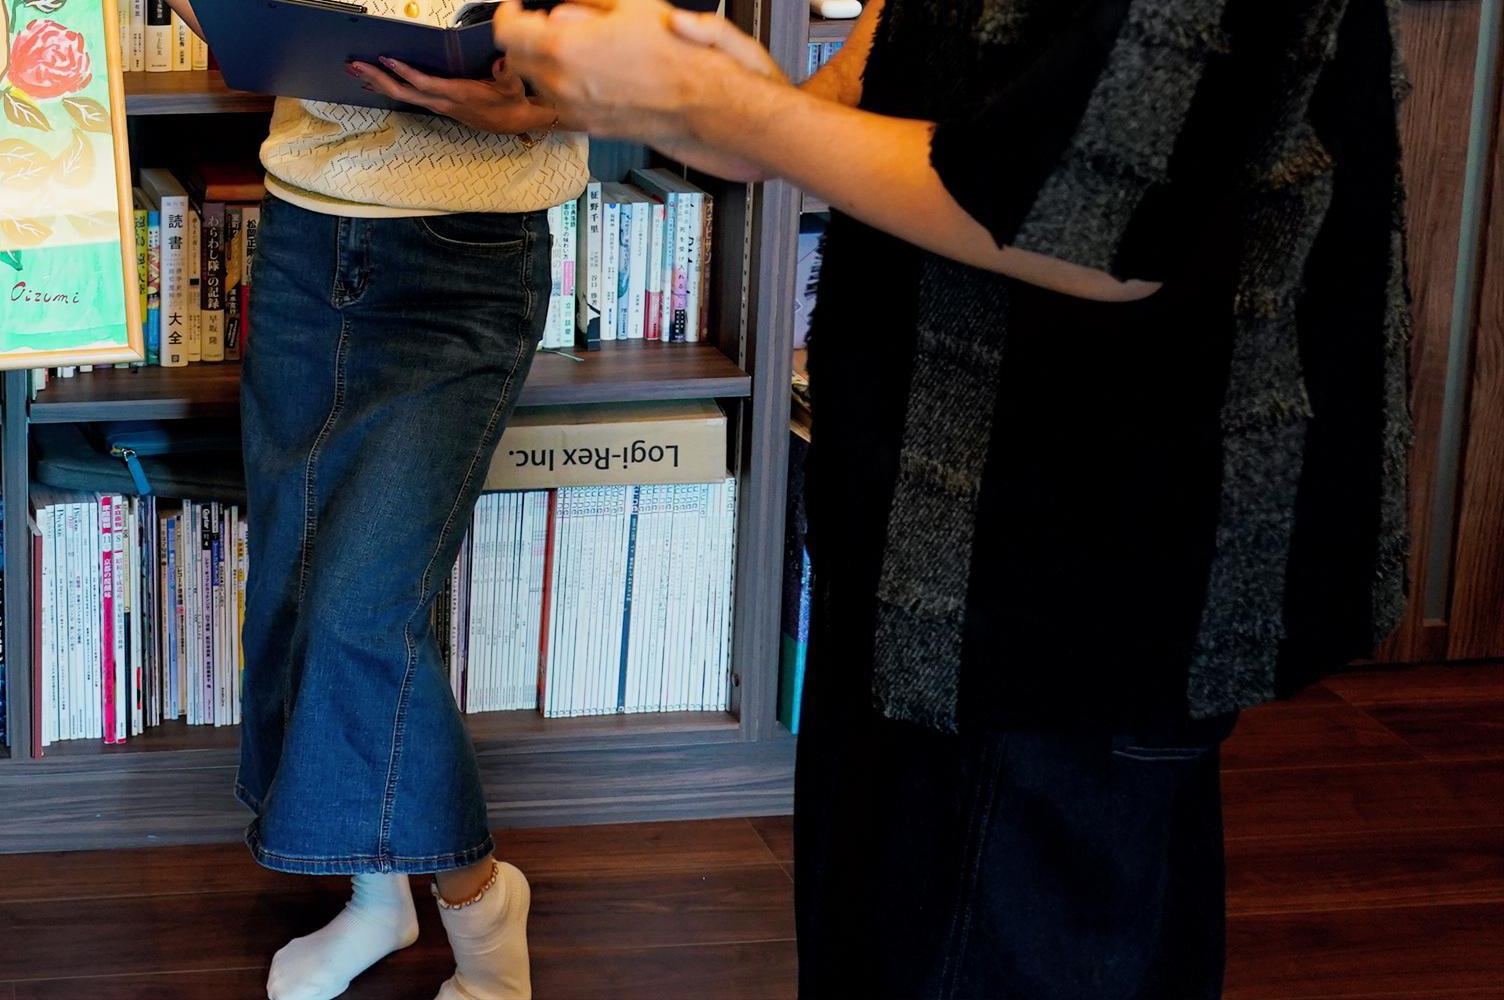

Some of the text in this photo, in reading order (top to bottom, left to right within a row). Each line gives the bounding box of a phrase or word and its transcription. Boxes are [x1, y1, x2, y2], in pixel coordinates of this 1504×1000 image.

[168, 215, 183, 250] 読書
[10, 281, 80, 304] Oizumi
[168, 312, 183, 345] 大全
[508, 440, 679, 471] Logi-Rex Inc.
